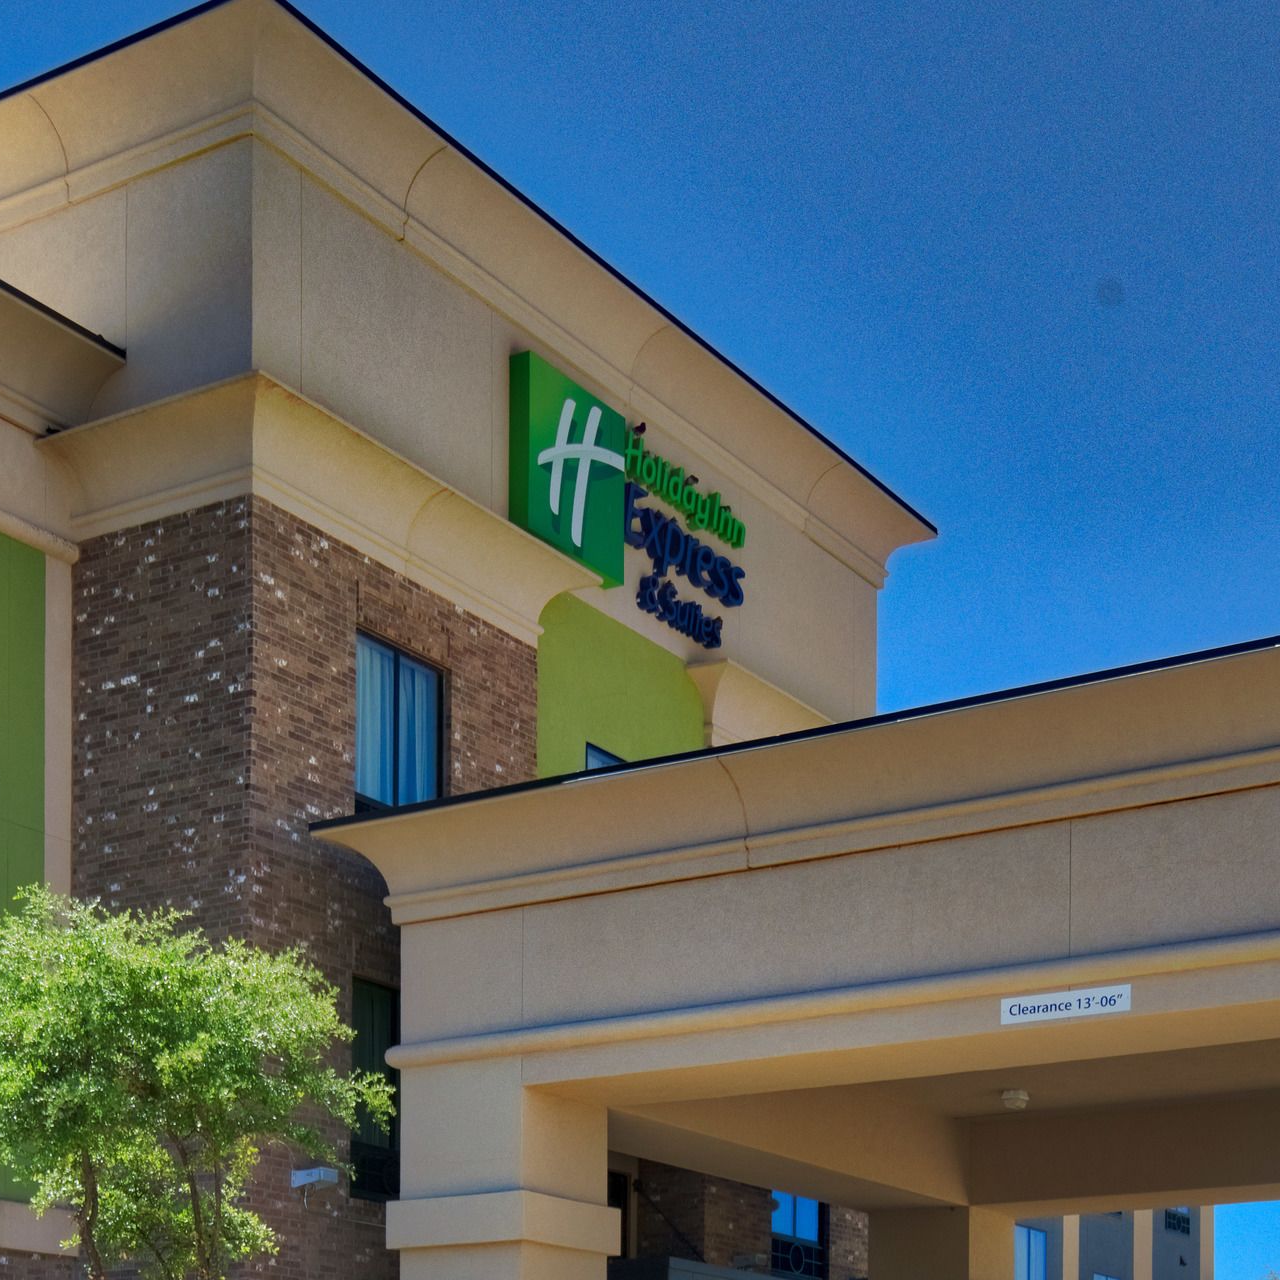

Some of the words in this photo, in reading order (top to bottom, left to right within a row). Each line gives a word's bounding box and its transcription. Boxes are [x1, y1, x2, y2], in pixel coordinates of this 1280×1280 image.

[624, 430, 708, 531] Holiday
[709, 492, 746, 549] Inn
[624, 481, 746, 608] Express
[656, 579, 723, 649] Suites
[1009, 1001, 1072, 1016] Clearance
